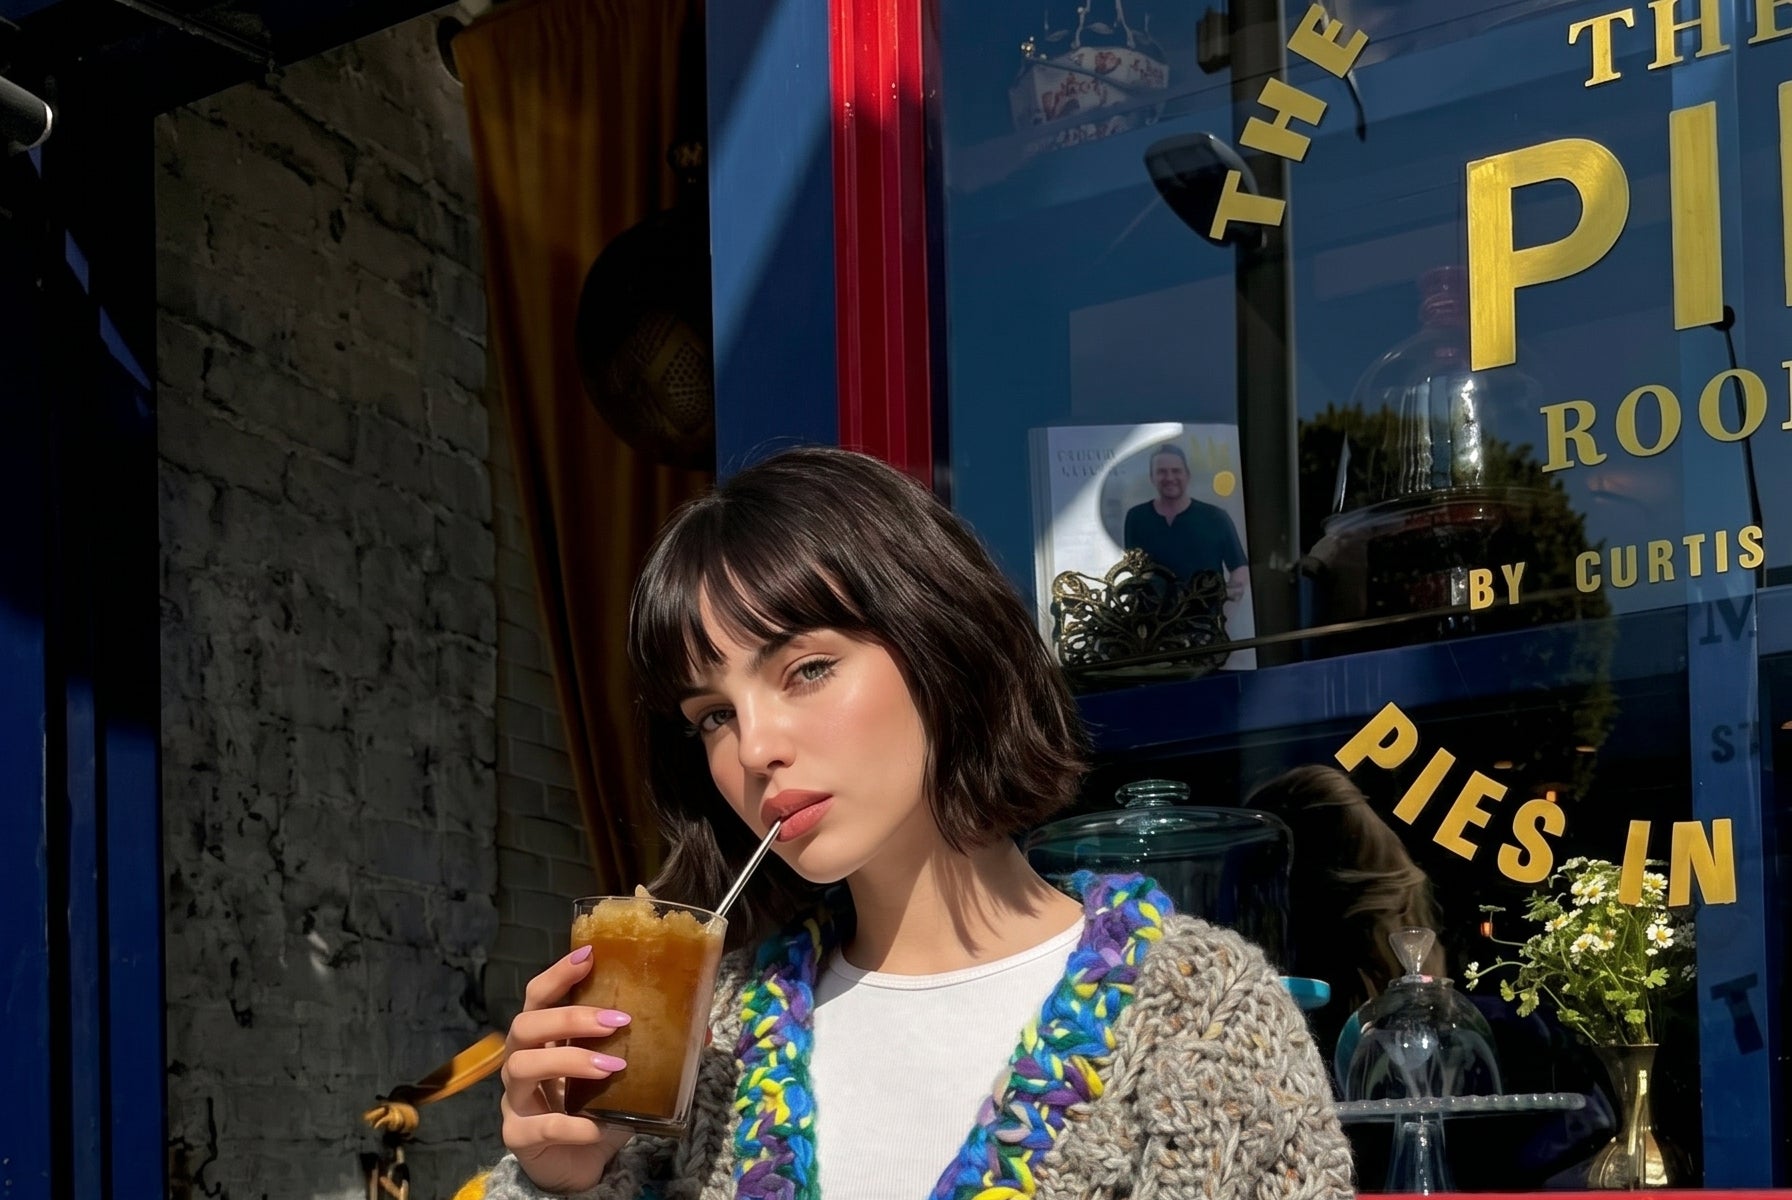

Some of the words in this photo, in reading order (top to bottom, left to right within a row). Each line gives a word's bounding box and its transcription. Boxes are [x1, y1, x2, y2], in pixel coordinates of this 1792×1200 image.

[1209, 4, 1369, 240] THE
[1466, 80, 1792, 372] PI
[1540, 361, 1792, 472] ROO
[1469, 562, 1526, 610] BY
[1575, 525, 1765, 593] CURTIS
[1334, 701, 1566, 884] PIES
[1619, 818, 1737, 907] IN
